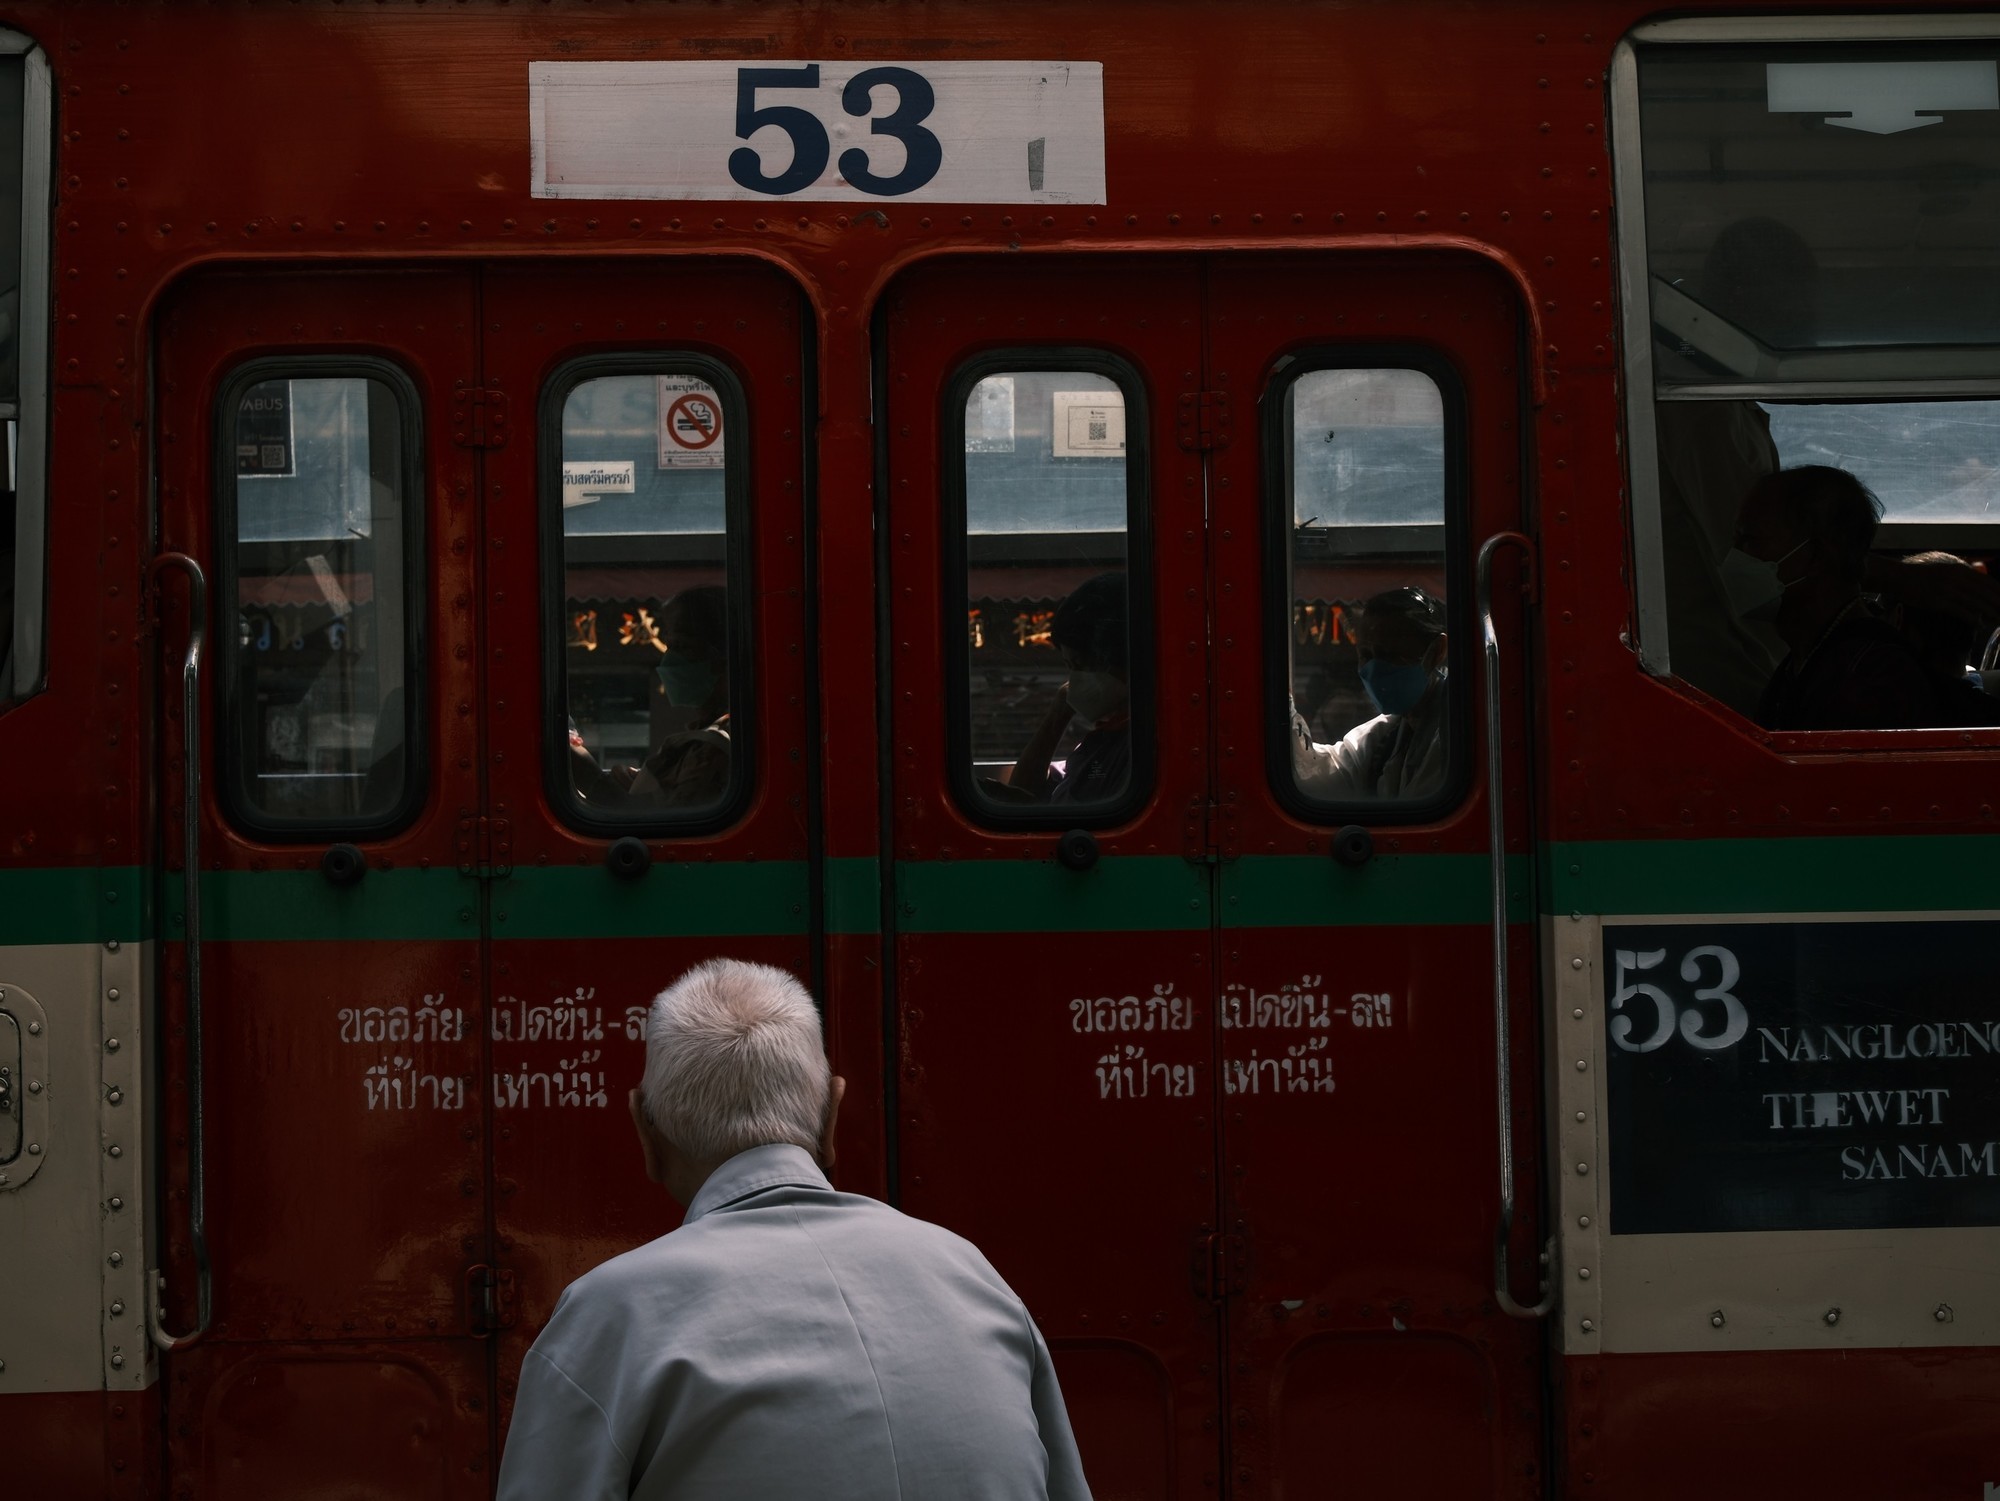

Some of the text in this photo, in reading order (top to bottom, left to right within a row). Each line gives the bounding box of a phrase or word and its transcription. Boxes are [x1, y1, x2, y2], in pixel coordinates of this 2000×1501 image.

[728, 63, 942, 197] 53
[337, 992, 464, 1043] ขออภัย
[1069, 982, 1193, 1032] ขออภัย
[1610, 944, 1749, 1053] 53
[363, 1048, 609, 1110] ที่ป้าย เท่านั้น
[1095, 1036, 1337, 1100] ที่ป้าย เท่านั้น
[1761, 1087, 1950, 1130] THEWET
